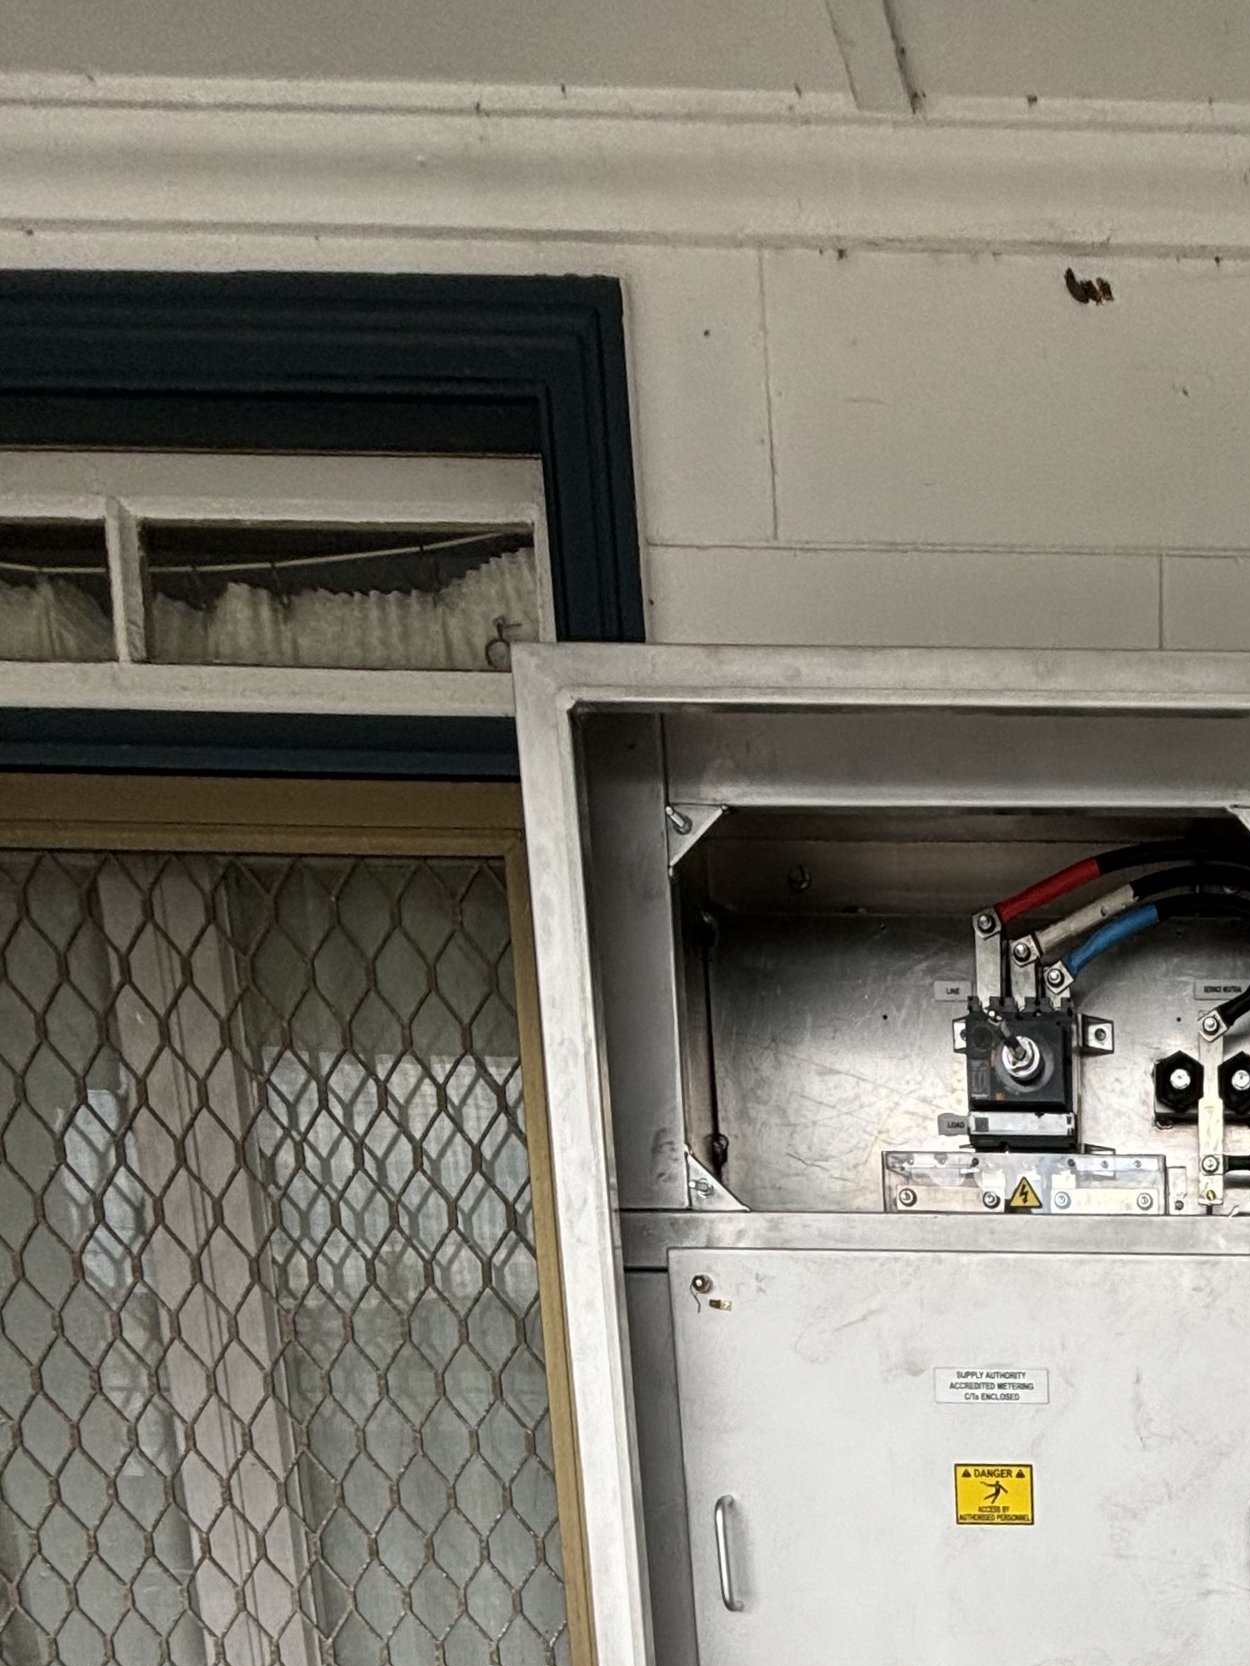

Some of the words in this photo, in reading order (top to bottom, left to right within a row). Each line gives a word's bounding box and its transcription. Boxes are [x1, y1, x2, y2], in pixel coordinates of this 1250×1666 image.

[947, 1121, 965, 1129] LOAD
[956, 1371, 983, 1379] SUPPLY
[985, 1371, 1026, 1380] AUTHORITY
[950, 1382, 995, 1390] ACCREDITED
[981, 1393, 1020, 1401] ENCLOSED
[974, 1469, 1013, 1478] DANGER
